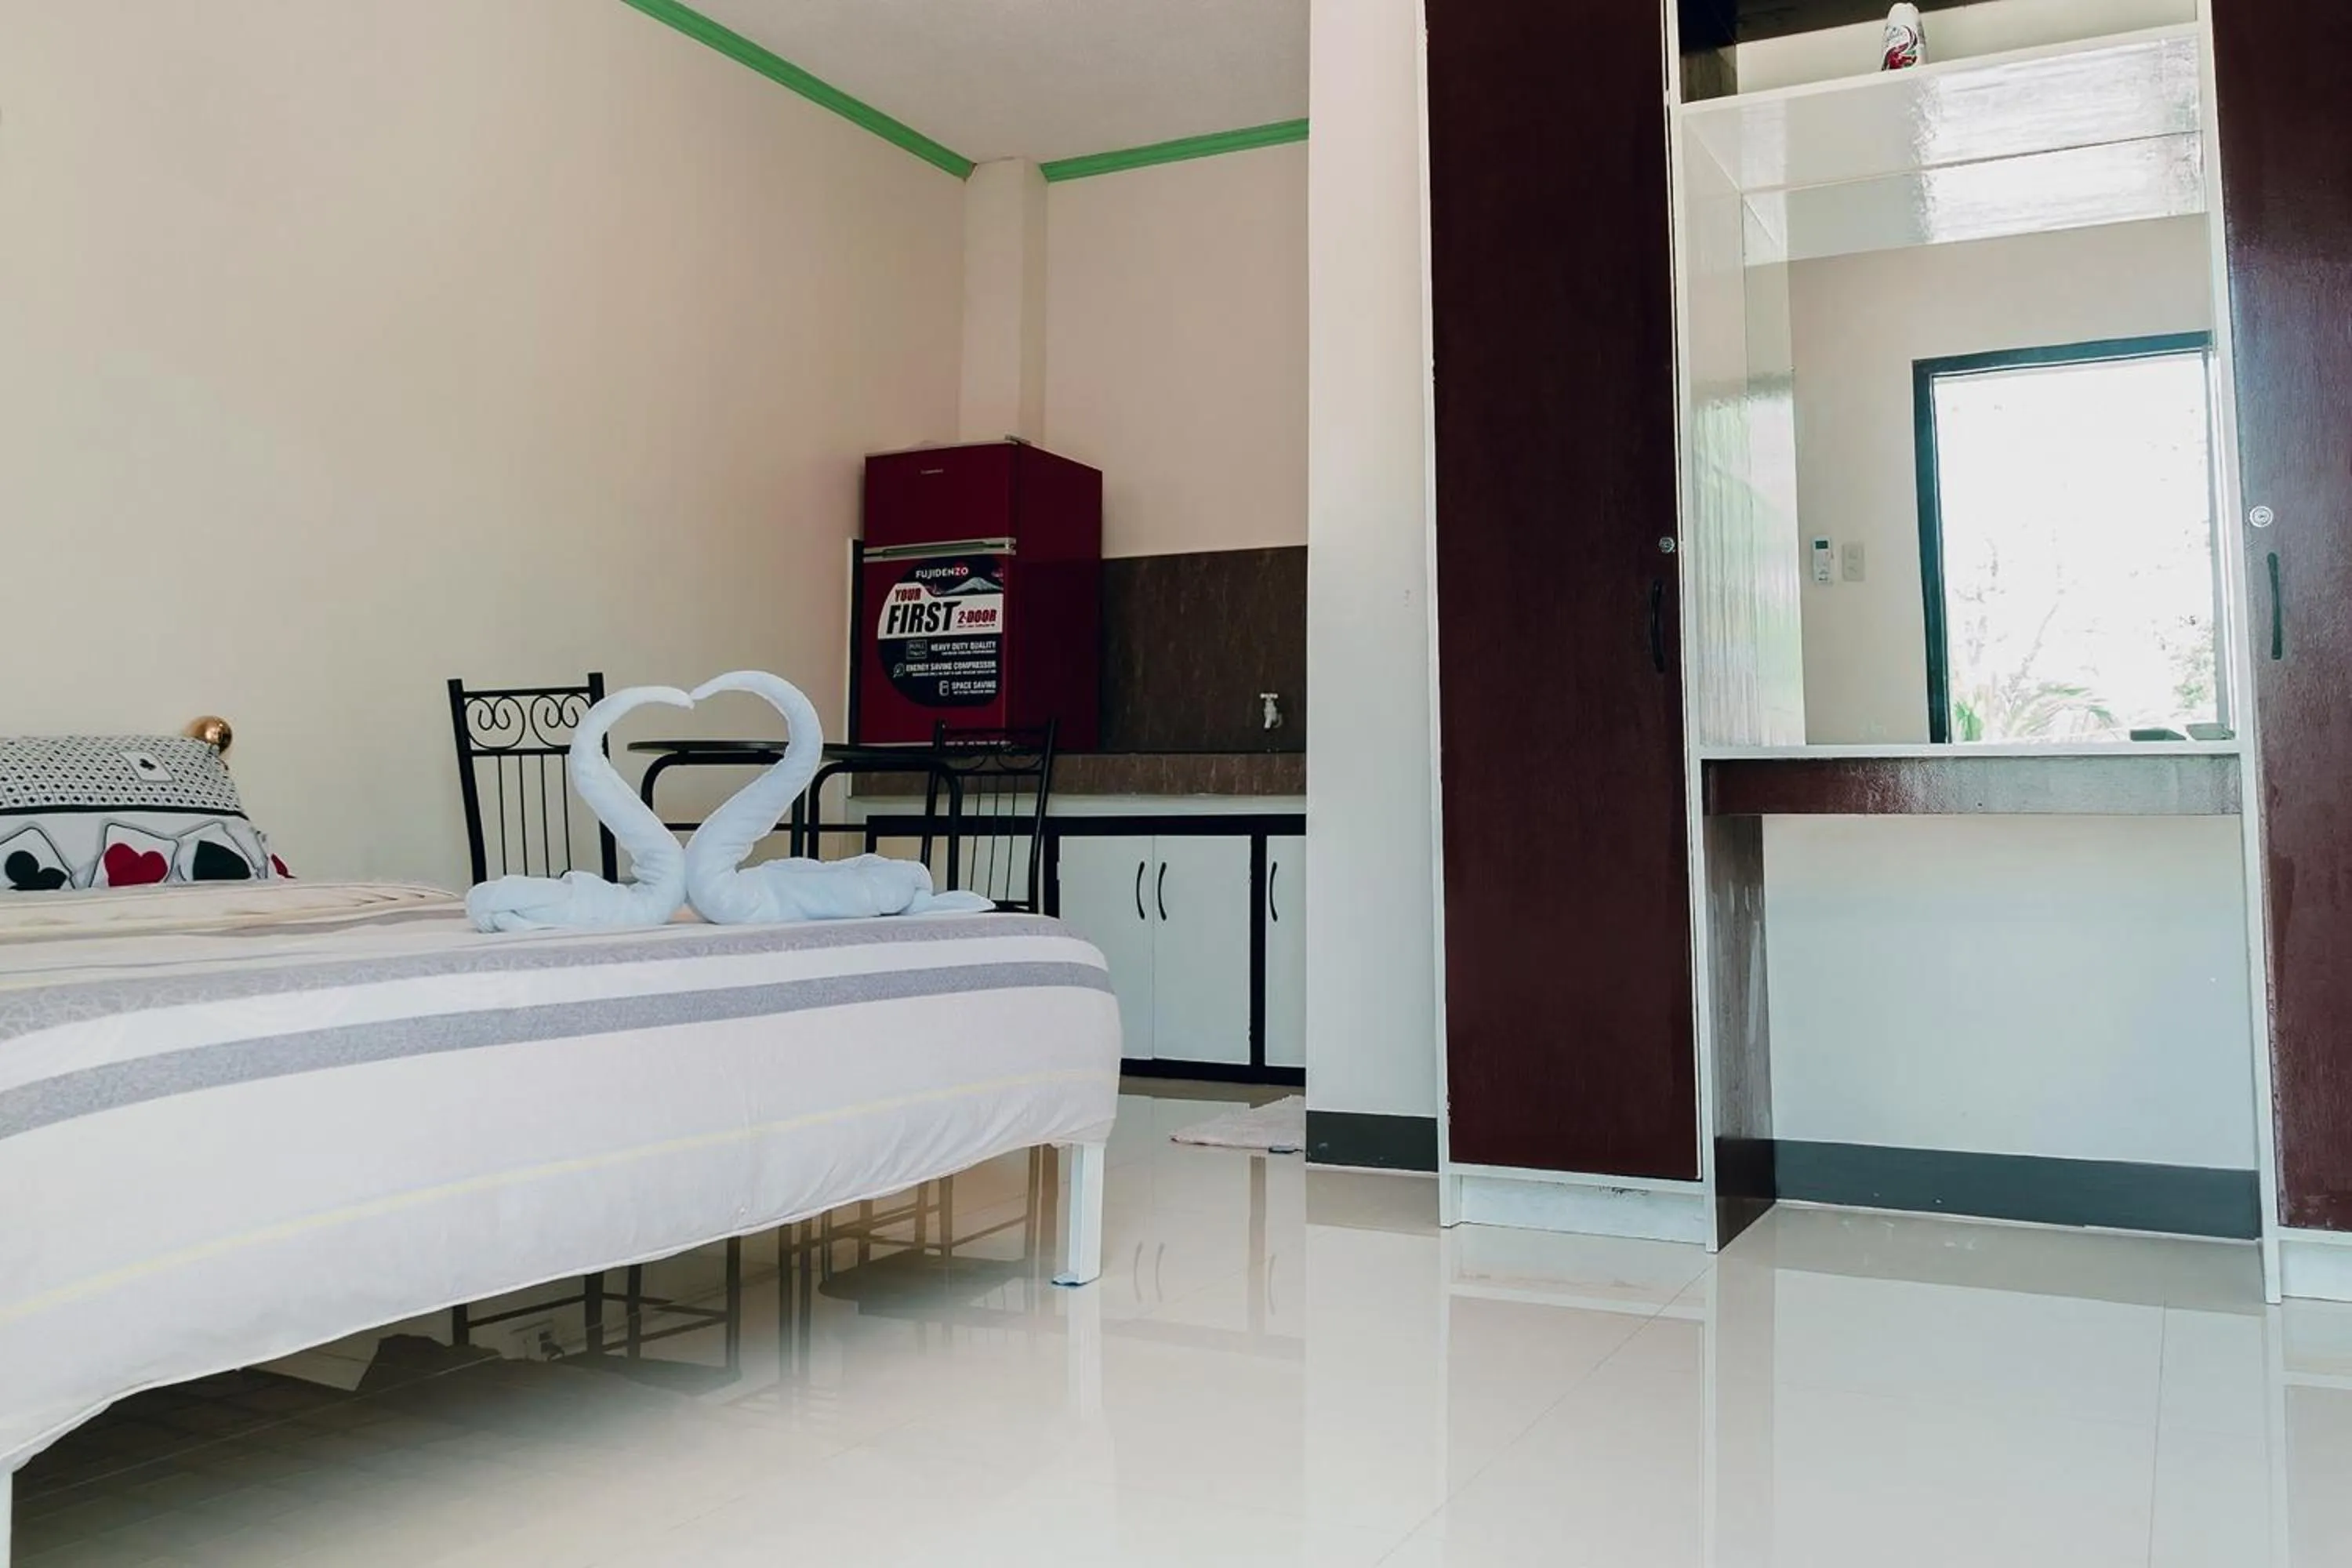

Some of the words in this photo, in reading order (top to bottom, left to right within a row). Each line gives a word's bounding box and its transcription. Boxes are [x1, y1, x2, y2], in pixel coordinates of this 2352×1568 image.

[915, 567, 968, 579] FUJIDENZO
[895, 588, 921, 602] YOUR
[887, 601, 962, 634] FIRST
[931, 643, 950, 652] HEAVY
[951, 641, 968, 651] DUTY
[970, 641, 996, 649] QUALITY
[930, 662, 953, 671] SAVING
[953, 660, 996, 670] COMPRESSOR
[951, 681, 971, 690] SPACE
[973, 680, 996, 689] SAVING
